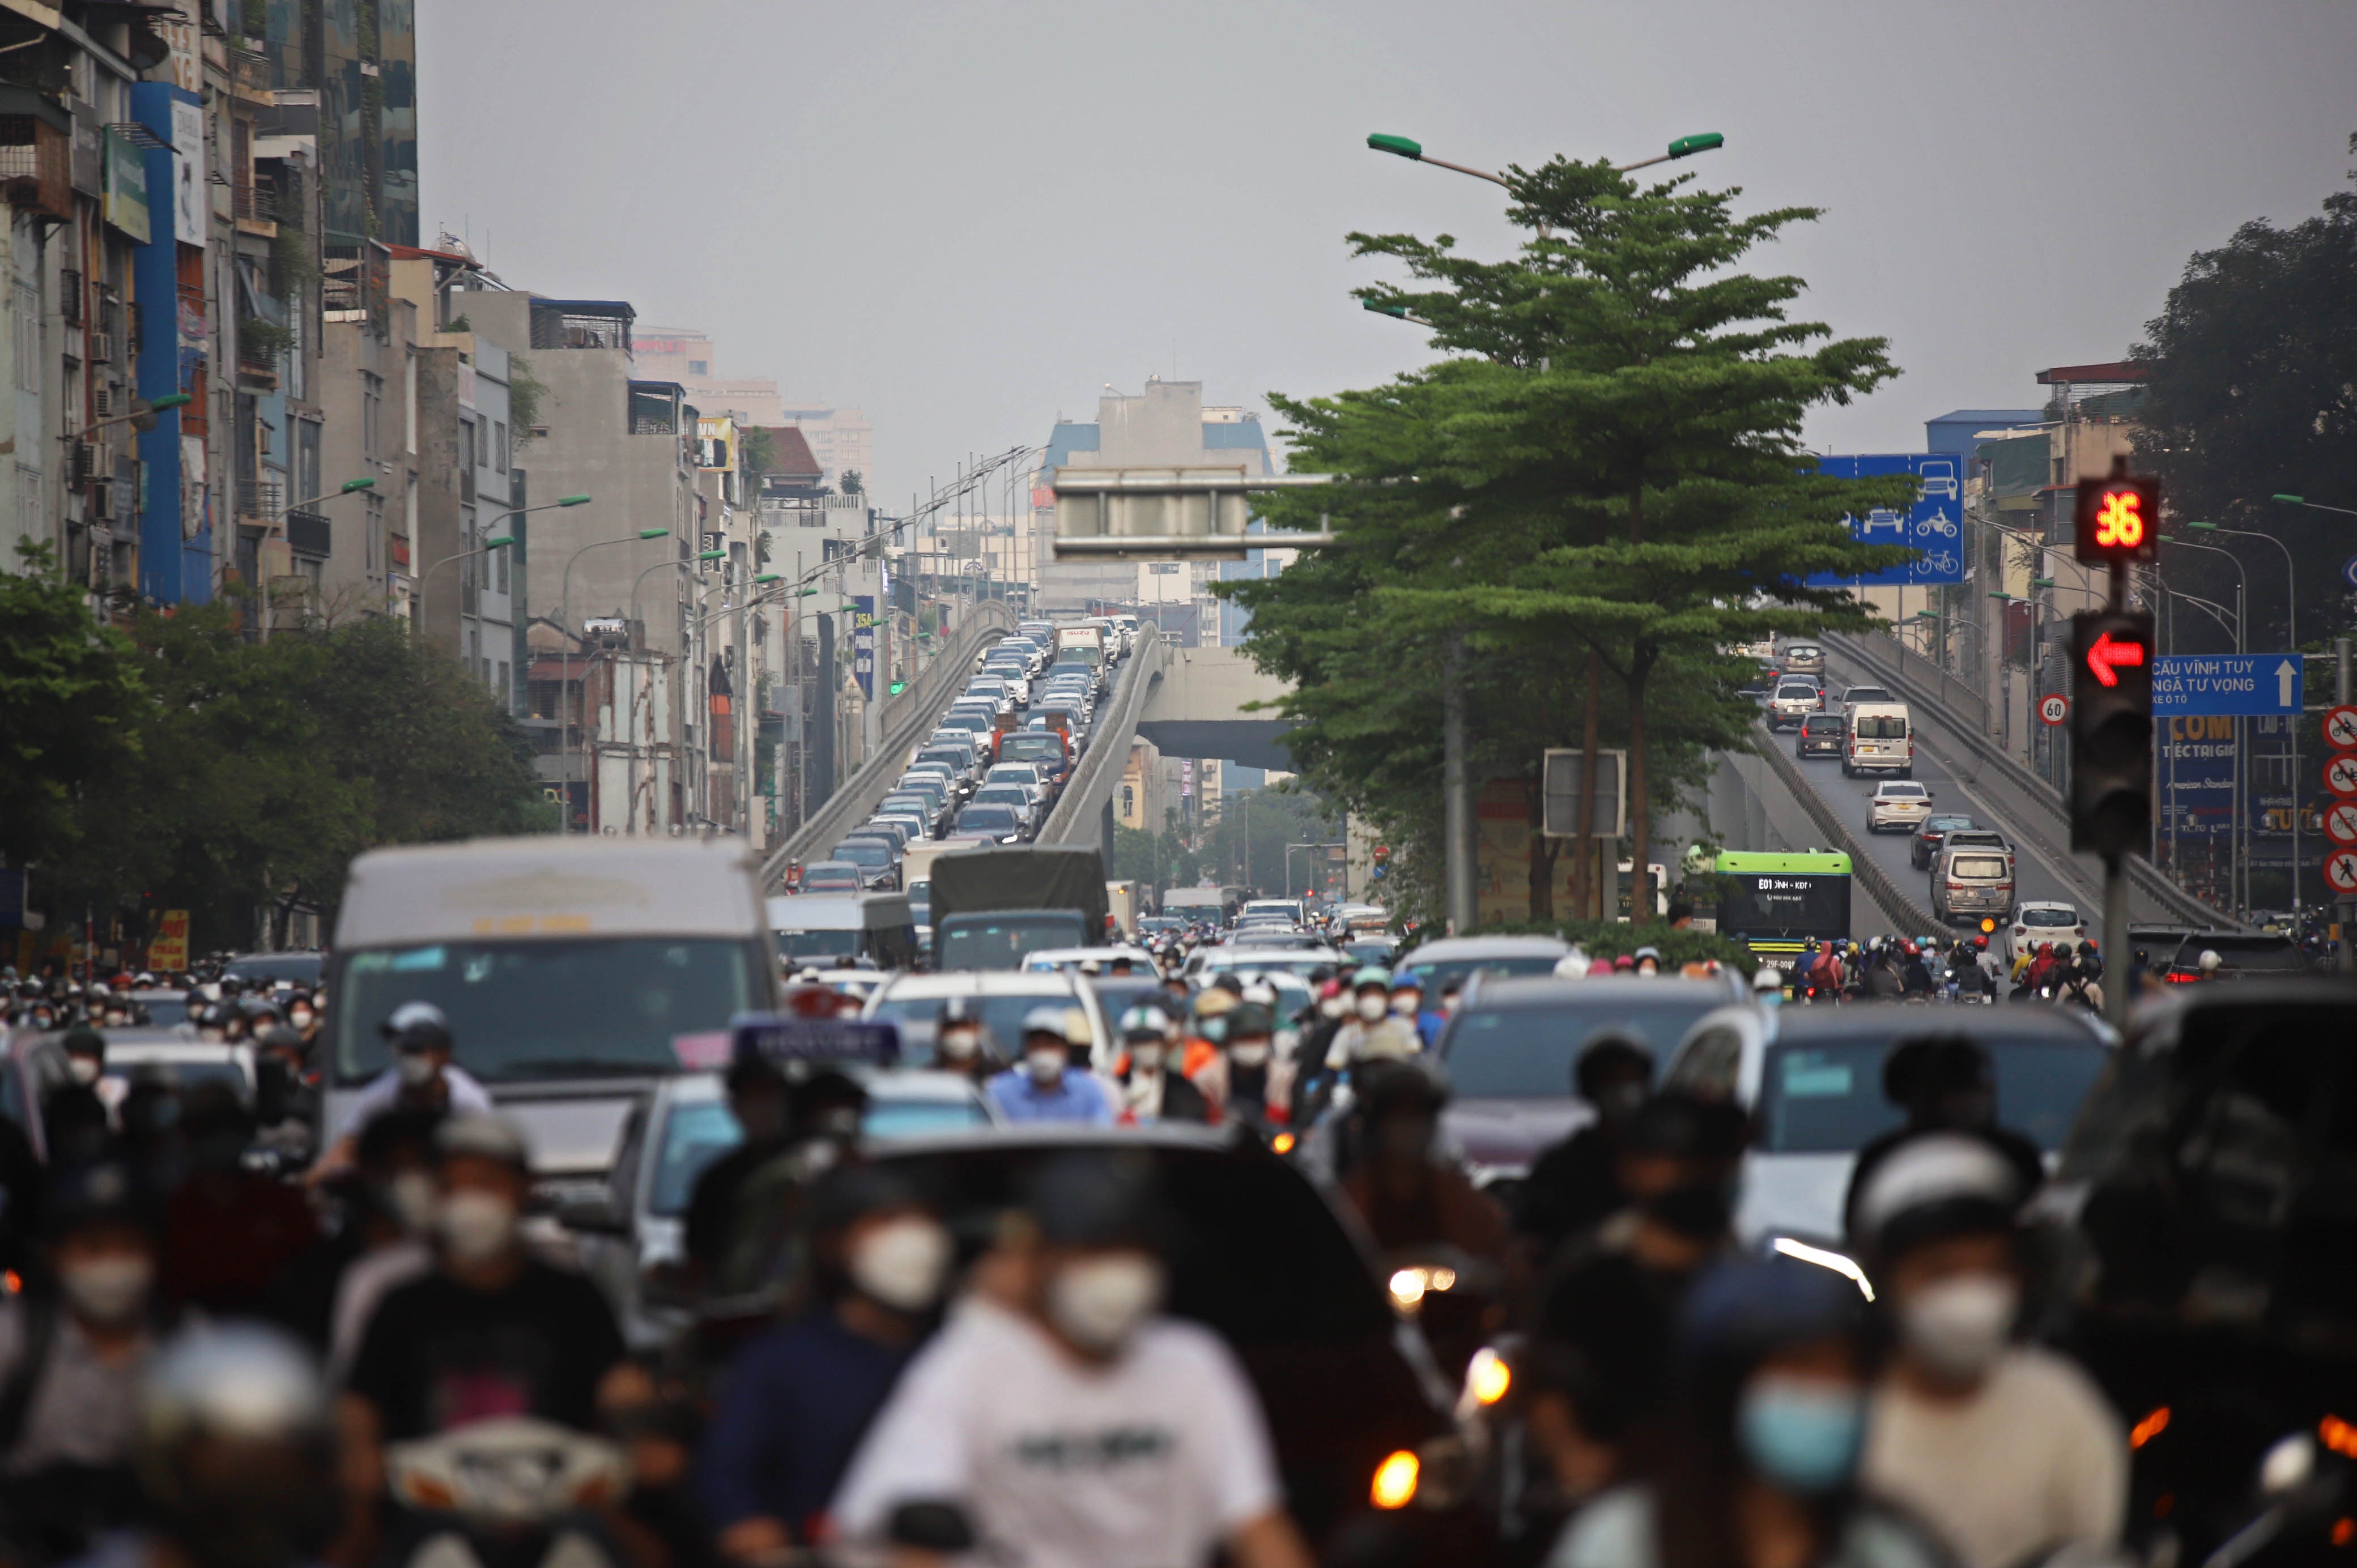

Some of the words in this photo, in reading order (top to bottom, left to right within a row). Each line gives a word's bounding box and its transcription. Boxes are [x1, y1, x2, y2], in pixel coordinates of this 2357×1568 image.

[2096, 491, 2143, 547] 36
[2184, 659, 2220, 675] VĨNH
[2223, 660, 2254, 674] TUY
[2152, 676, 2183, 692] NGÃ
[2186, 678, 2209, 692] TƯ
[2211, 678, 2255, 695] VỌNG
[2152, 695, 2164, 704] XE
[2047, 702, 2061, 717] 60
[1759, 878, 1772, 890] E01
